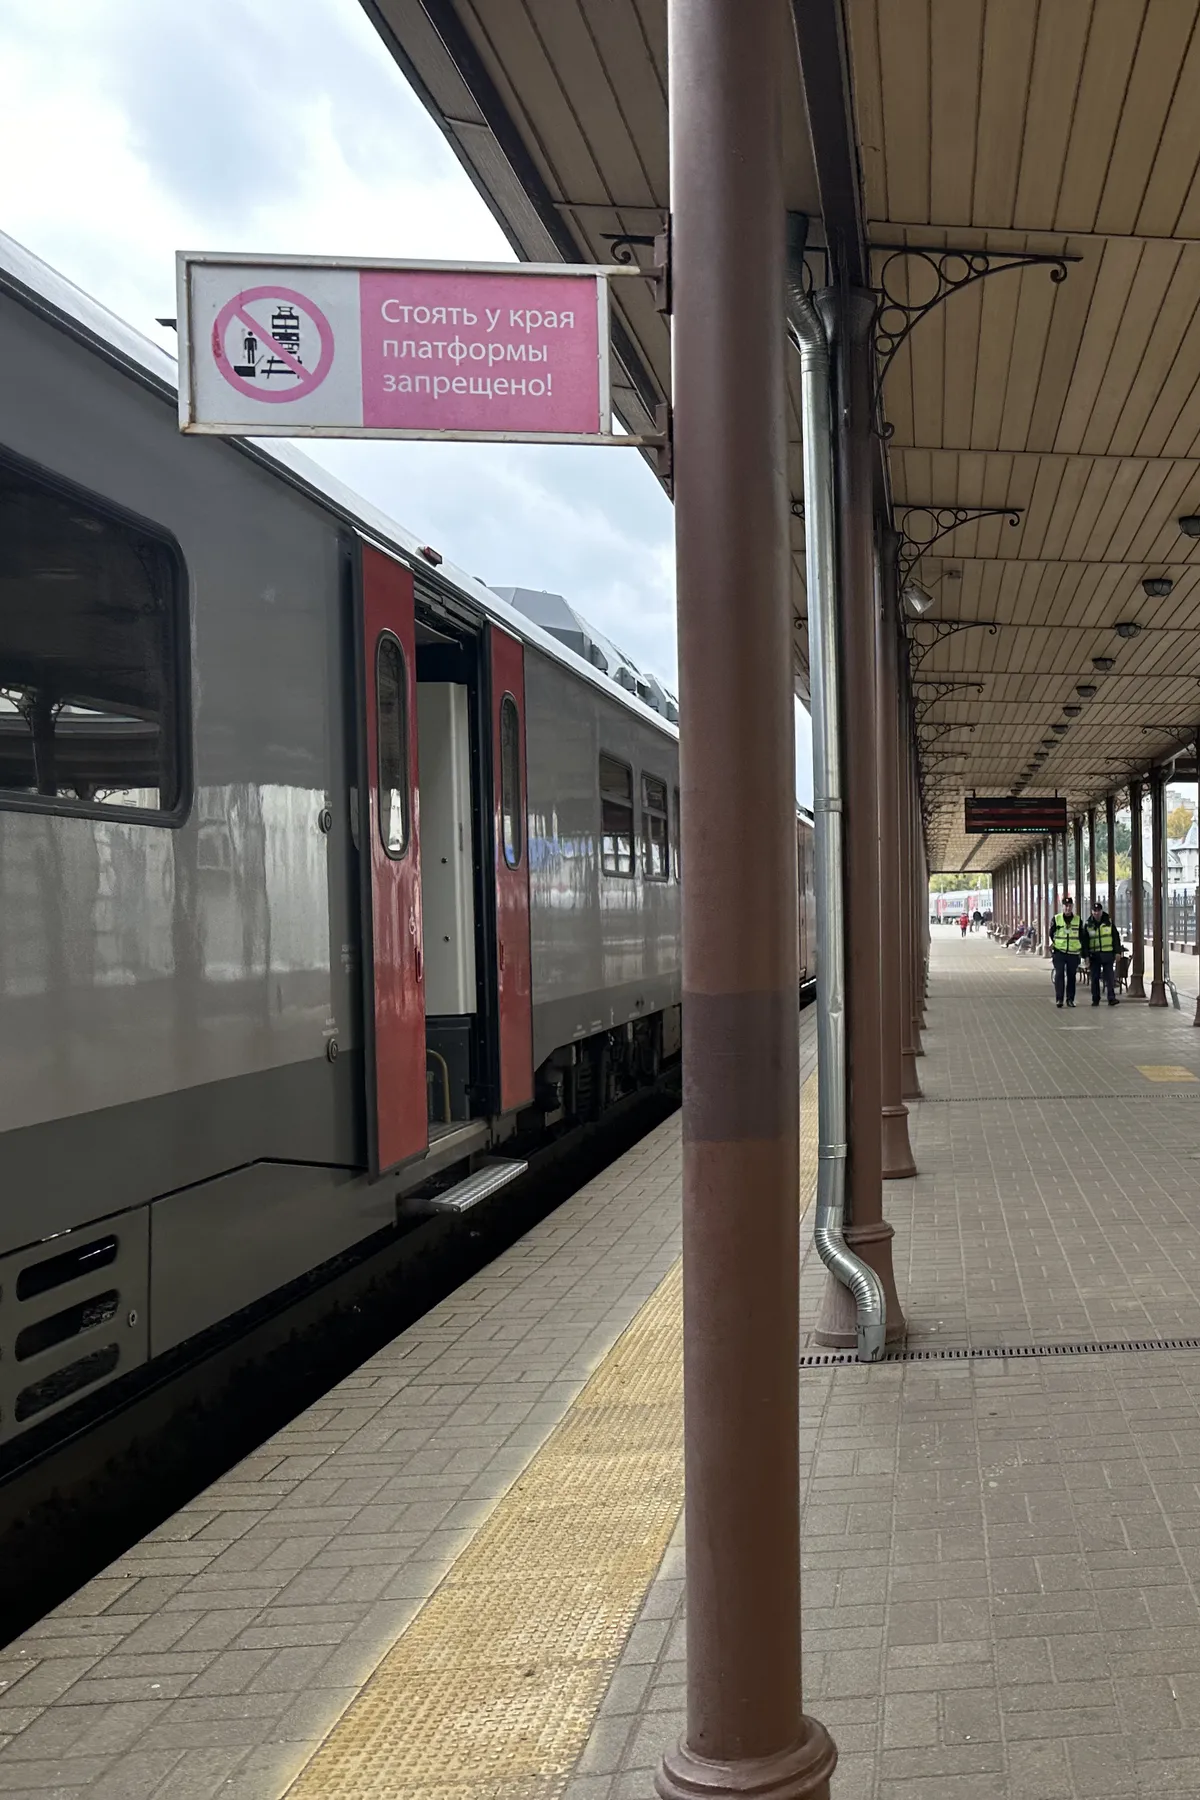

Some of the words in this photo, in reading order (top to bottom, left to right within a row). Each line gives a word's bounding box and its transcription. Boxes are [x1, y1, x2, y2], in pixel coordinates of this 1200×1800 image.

[381, 299, 478, 326] Стоять
[485, 308, 501, 333] у
[509, 309, 575, 334] края
[383, 335, 548, 367] платформы
[383, 373, 553, 400] запрещено!
